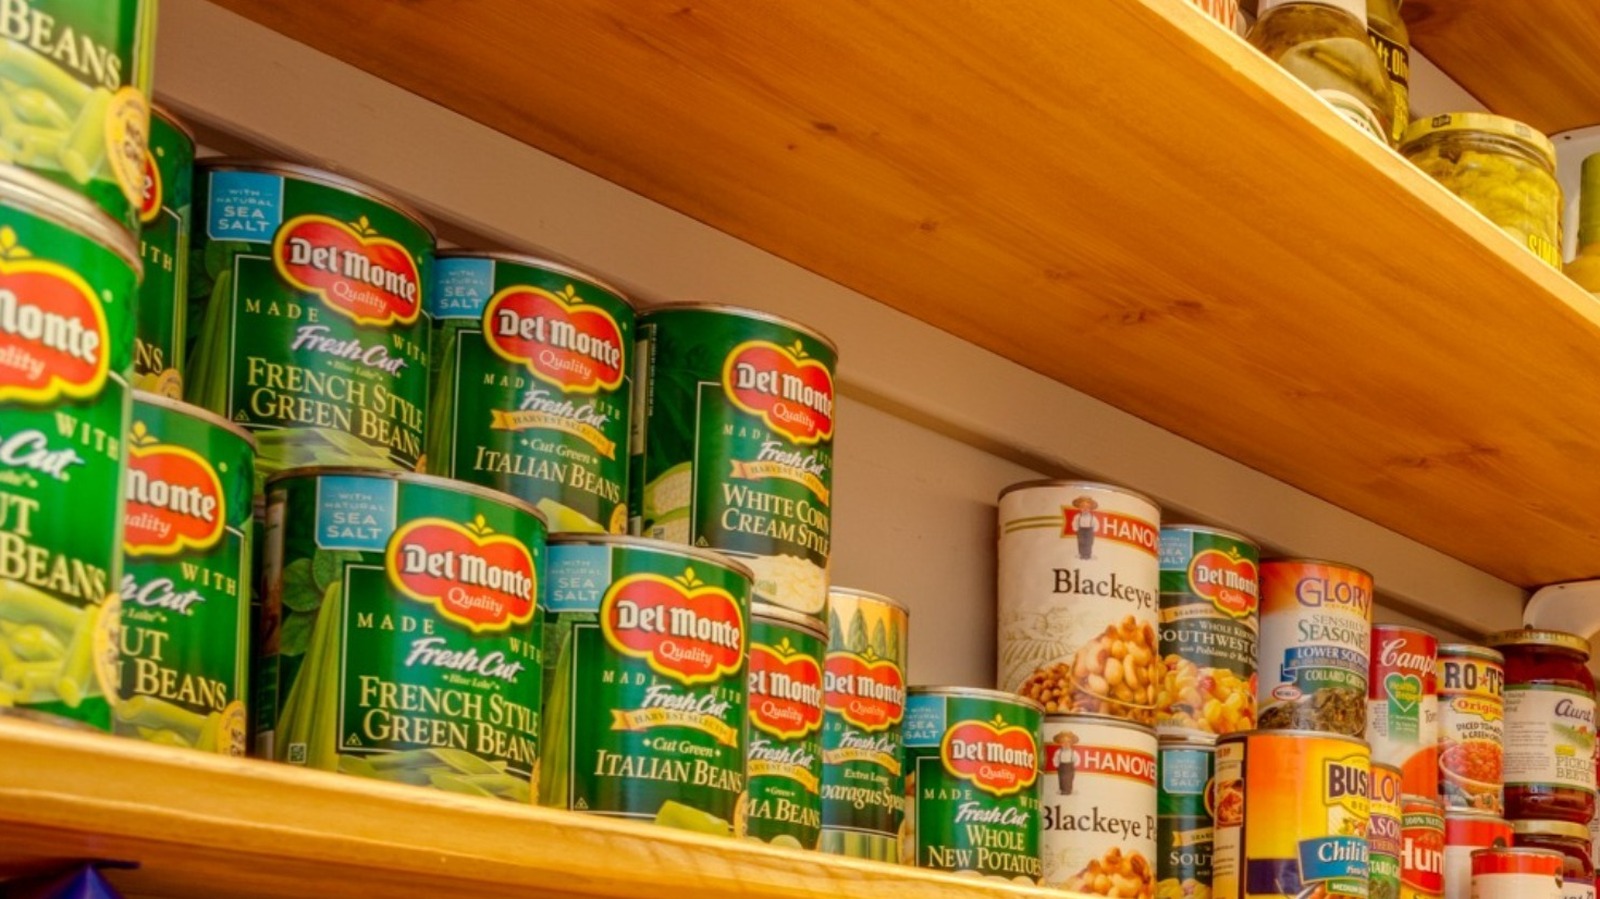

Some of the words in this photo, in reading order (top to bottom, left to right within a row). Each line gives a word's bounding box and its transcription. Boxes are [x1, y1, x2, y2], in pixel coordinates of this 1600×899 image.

[0, 0, 122, 93] BEANS
[216, 196, 274, 207] NATURAL
[228, 188, 261, 197] WITH
[217, 218, 271, 232] SALT
[223, 205, 266, 219] SEA
[140, 241, 173, 272] ITH
[289, 237, 338, 273] Del
[343, 249, 417, 304] Monte
[332, 280, 388, 313] Quality
[439, 298, 483, 310] SALT
[443, 286, 479, 298] SEA
[245, 297, 320, 323] MADE
[291, 324, 363, 362] Fresh
[361, 344, 409, 378] Cut
[497, 307, 545, 343] Del
[548, 317, 621, 370] Monte
[538, 349, 593, 380] Quality
[736, 362, 779, 396] Del
[247, 355, 366, 408] FRENCH
[372, 383, 424, 434] STYLE
[519, 388, 576, 419] Fresh
[251, 386, 353, 432] GREEN
[360, 407, 421, 461] BEANS
[513, 413, 563, 426] HARVEST
[772, 402, 816, 432] Quality
[55, 411, 118, 460] WITH
[530, 438, 554, 451] Cut
[556, 444, 591, 464] Green
[756, 440, 803, 469] Fresh
[473, 445, 568, 485] ITALIAN
[569, 462, 621, 504] BEANS
[324, 501, 387, 512] NATURAL
[338, 492, 373, 501] WITH
[721, 482, 795, 519] WHITE
[326, 525, 383, 540] SALT
[332, 511, 378, 526] SEA
[721, 507, 798, 543] CREAM
[1102, 516, 1159, 551] HANOV
[0, 530, 107, 605] BEANS
[403, 543, 455, 580] Del
[458, 551, 533, 601] Monte
[1160, 556, 1185, 565] ALT
[1197, 564, 1224, 585] Del
[180, 562, 237, 596] WITH
[557, 576, 595, 589] SEA
[1052, 567, 1153, 611] Blackeye
[447, 586, 504, 617] Quality
[553, 589, 599, 601] SALT
[1295, 576, 1371, 620] GLORY
[356, 612, 436, 636] MADE
[616, 599, 666, 634] Del
[669, 605, 741, 650] Monte
[1200, 621, 1232, 634] WHOLE
[121, 626, 169, 660] UT
[659, 639, 714, 669] Quality
[1297, 646, 1340, 659] LOWER
[404, 636, 477, 672] Fresh
[477, 650, 526, 683] Cut
[134, 658, 227, 711] BEANS
[749, 669, 768, 694] el
[358, 674, 483, 721] FRENCH
[488, 692, 539, 737] STYLE
[640, 684, 697, 712] Fresh
[760, 700, 804, 726] Quality
[633, 709, 685, 724] HARVEST
[908, 720, 936, 730] SEA
[362, 707, 469, 750] GREEN
[476, 721, 537, 766] BEANS
[652, 737, 677, 751] Cut
[678, 740, 714, 758] Green
[905, 730, 940, 740] SALT
[951, 738, 983, 760] Del
[986, 741, 1035, 769] Monte
[593, 749, 691, 783] ITALIAN
[692, 758, 743, 794] BEANS
[843, 768, 870, 780] Extra
[870, 769, 890, 787] Long
[979, 766, 1017, 784] Quality
[1328, 763, 1368, 798] BUS
[822, 783, 882, 810] paragus
[923, 788, 973, 801] MADE
[775, 797, 821, 830] BEANS
[953, 800, 1001, 824] Fresh
[1000, 806, 1031, 828] Cut
[965, 824, 1026, 851] WHOLE
[1317, 840, 1360, 863] Chili
[927, 845, 973, 869] NEW
[975, 846, 1042, 877] POTATOES
[1400, 837, 1443, 875] Hun
